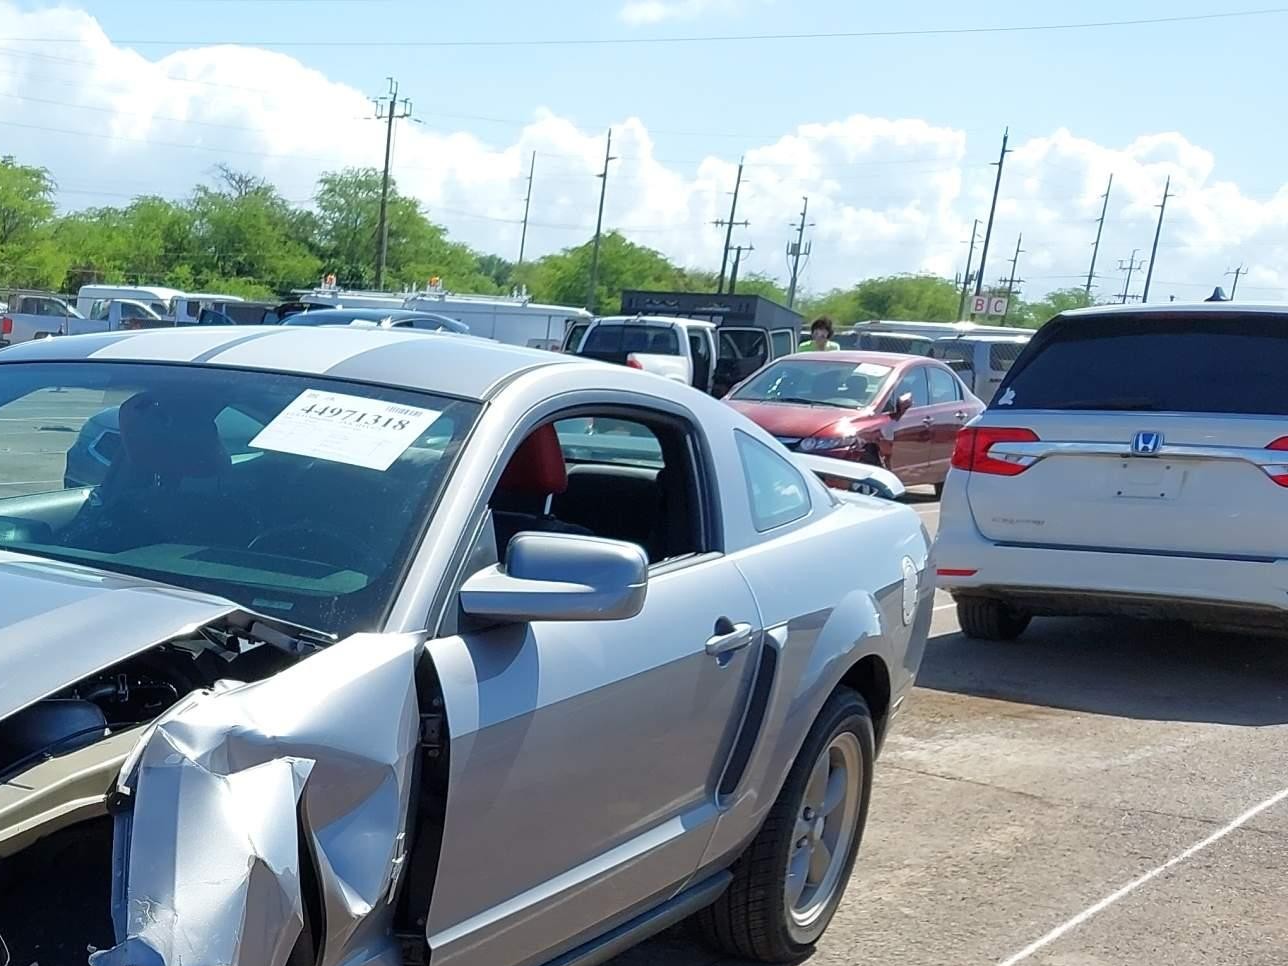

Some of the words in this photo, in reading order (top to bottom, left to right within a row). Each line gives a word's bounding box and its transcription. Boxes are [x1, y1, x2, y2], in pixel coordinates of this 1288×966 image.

[975, 299, 985, 311] B
[995, 300, 1004, 312] C
[300, 403, 411, 432] 44971318
